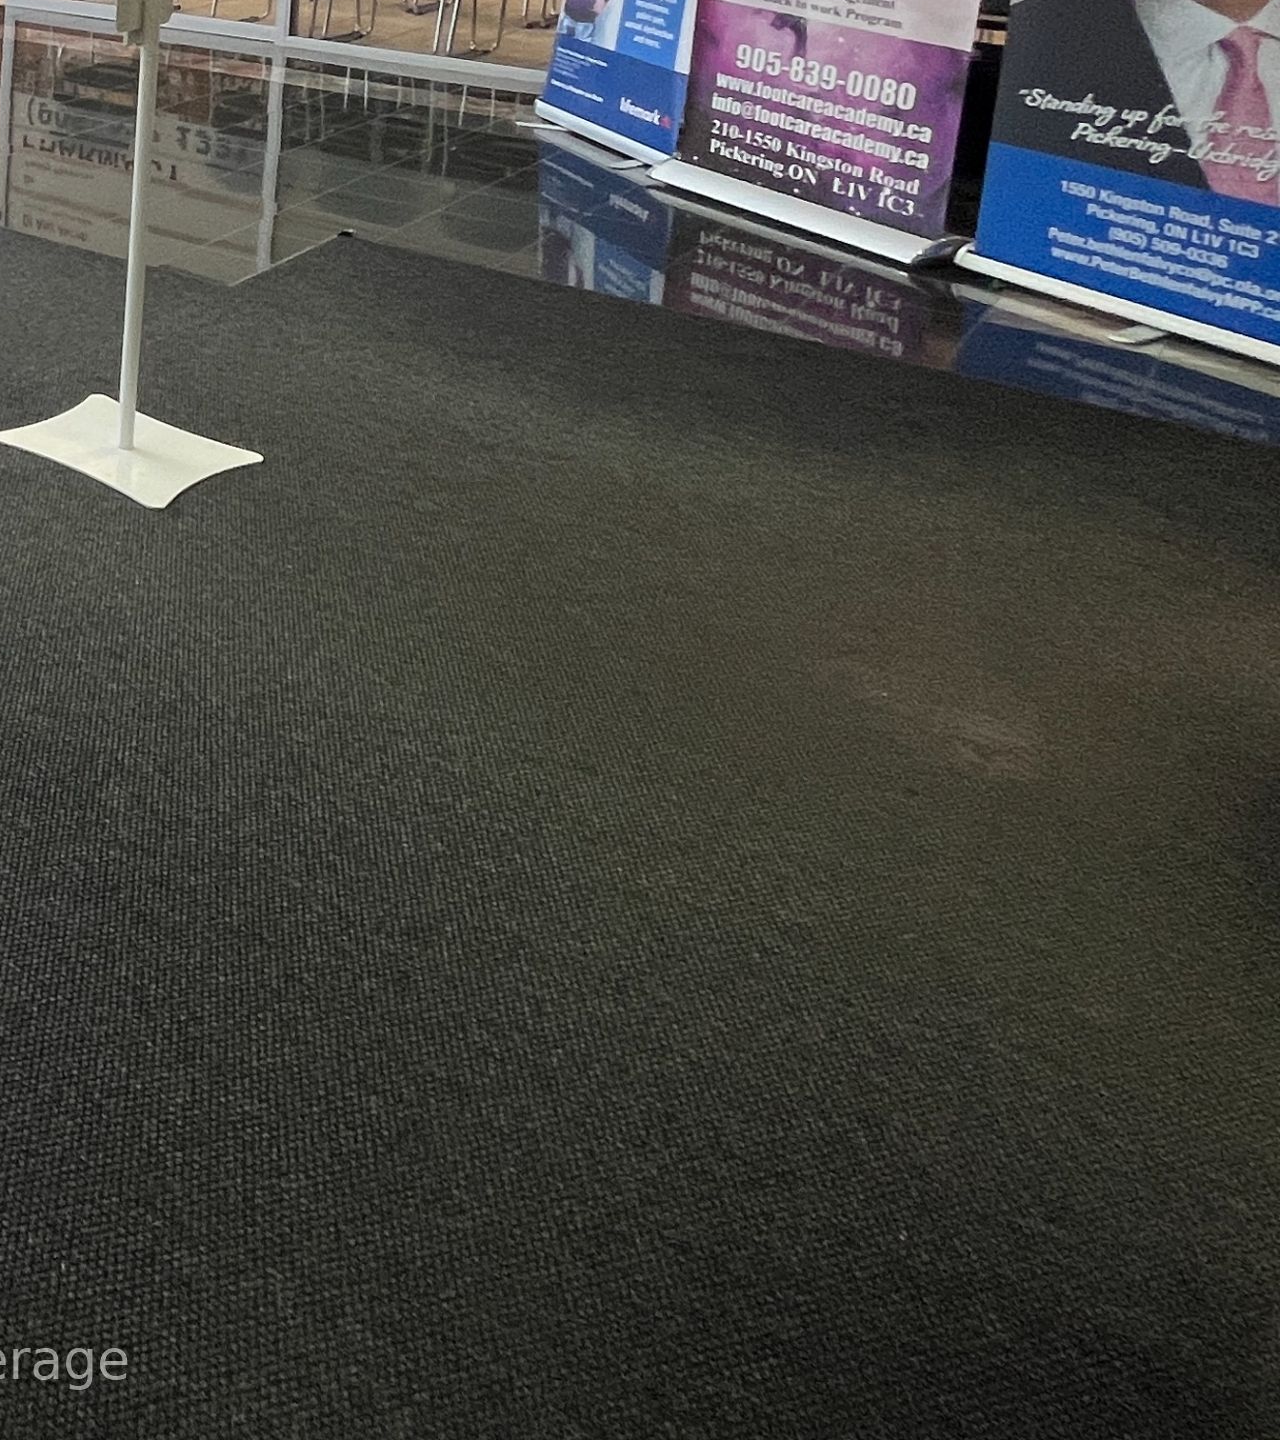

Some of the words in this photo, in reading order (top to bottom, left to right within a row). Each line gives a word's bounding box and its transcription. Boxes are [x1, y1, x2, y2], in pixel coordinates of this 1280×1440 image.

[846, 8, 903, 30] Program
[715, 72, 933, 144] www.footcareacademy.ca
[736, 43, 918, 110] 905-839-0080
[711, 93, 930, 170] info@footcareacademy.ca
[1121, 109, 1148, 128] up
[709, 139, 785, 179] Pickering
[788, 164, 818, 186] ON
[878, 187, 915, 216] 1C3
[711, 119, 782, 153] 210-1550
[785, 141, 863, 178] Kingston
[869, 164, 920, 196] Road
[1061, 180, 1096, 199] 1550
[1099, 189, 1164, 216] Kingston
[1218, 218, 1262, 240] Suite
[1109, 226, 1147, 249] (905)
[1163, 222, 1188, 240] ON
